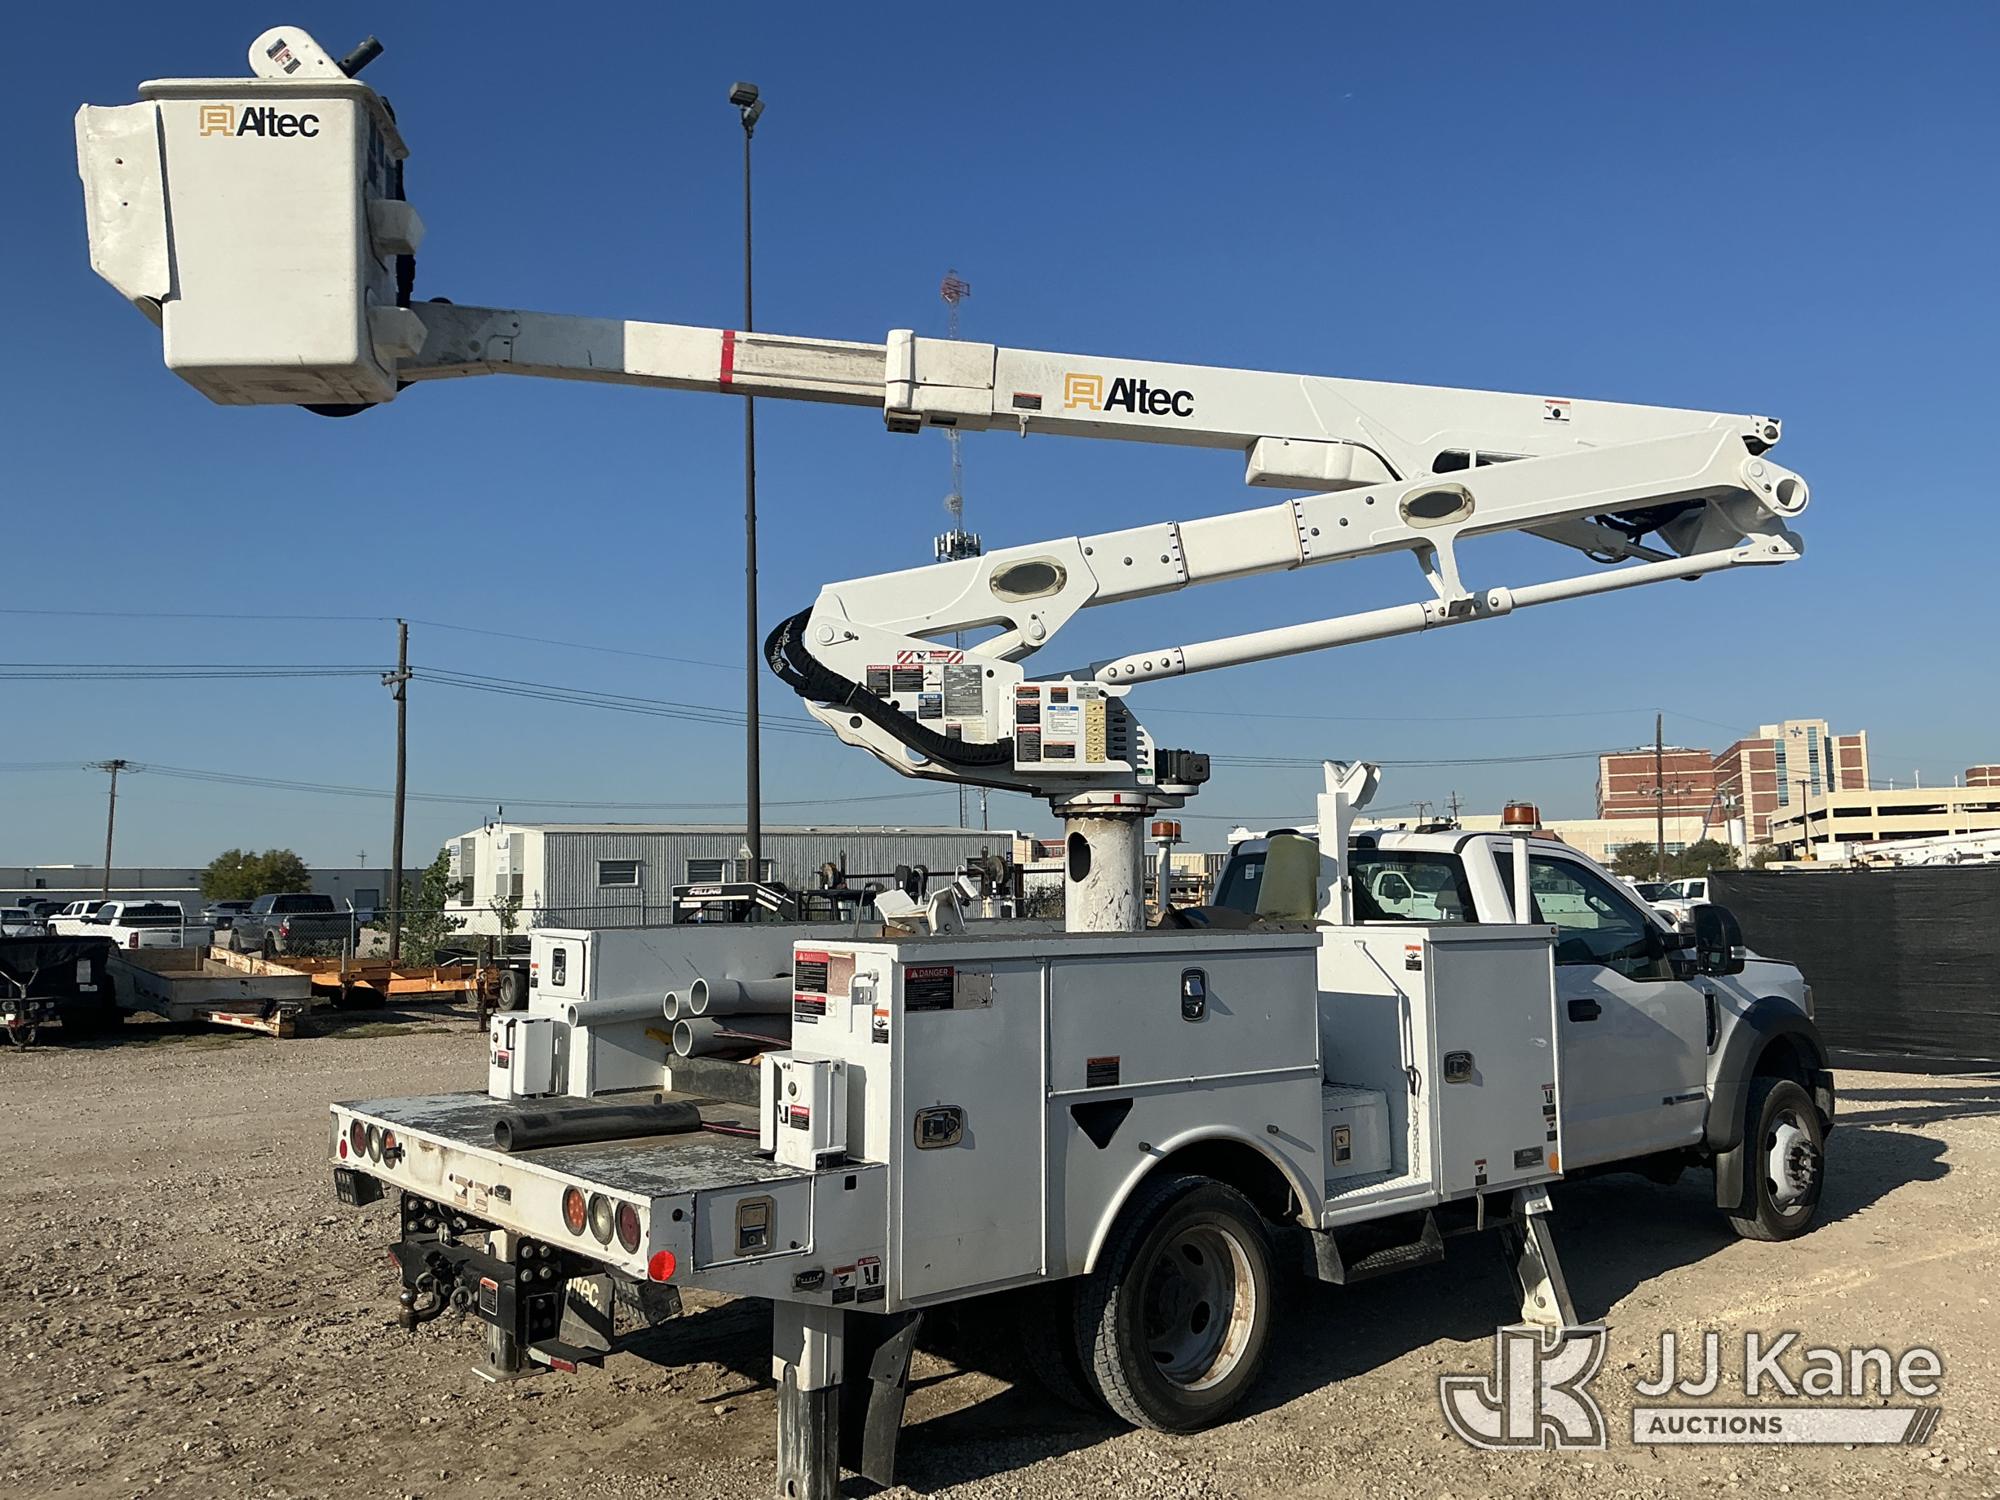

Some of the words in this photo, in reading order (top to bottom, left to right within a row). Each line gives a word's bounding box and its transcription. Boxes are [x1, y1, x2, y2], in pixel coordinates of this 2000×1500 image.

[236, 107, 320, 137] Altec
[1103, 377, 1195, 417] Altec
[919, 968, 948, 977] DANGER
